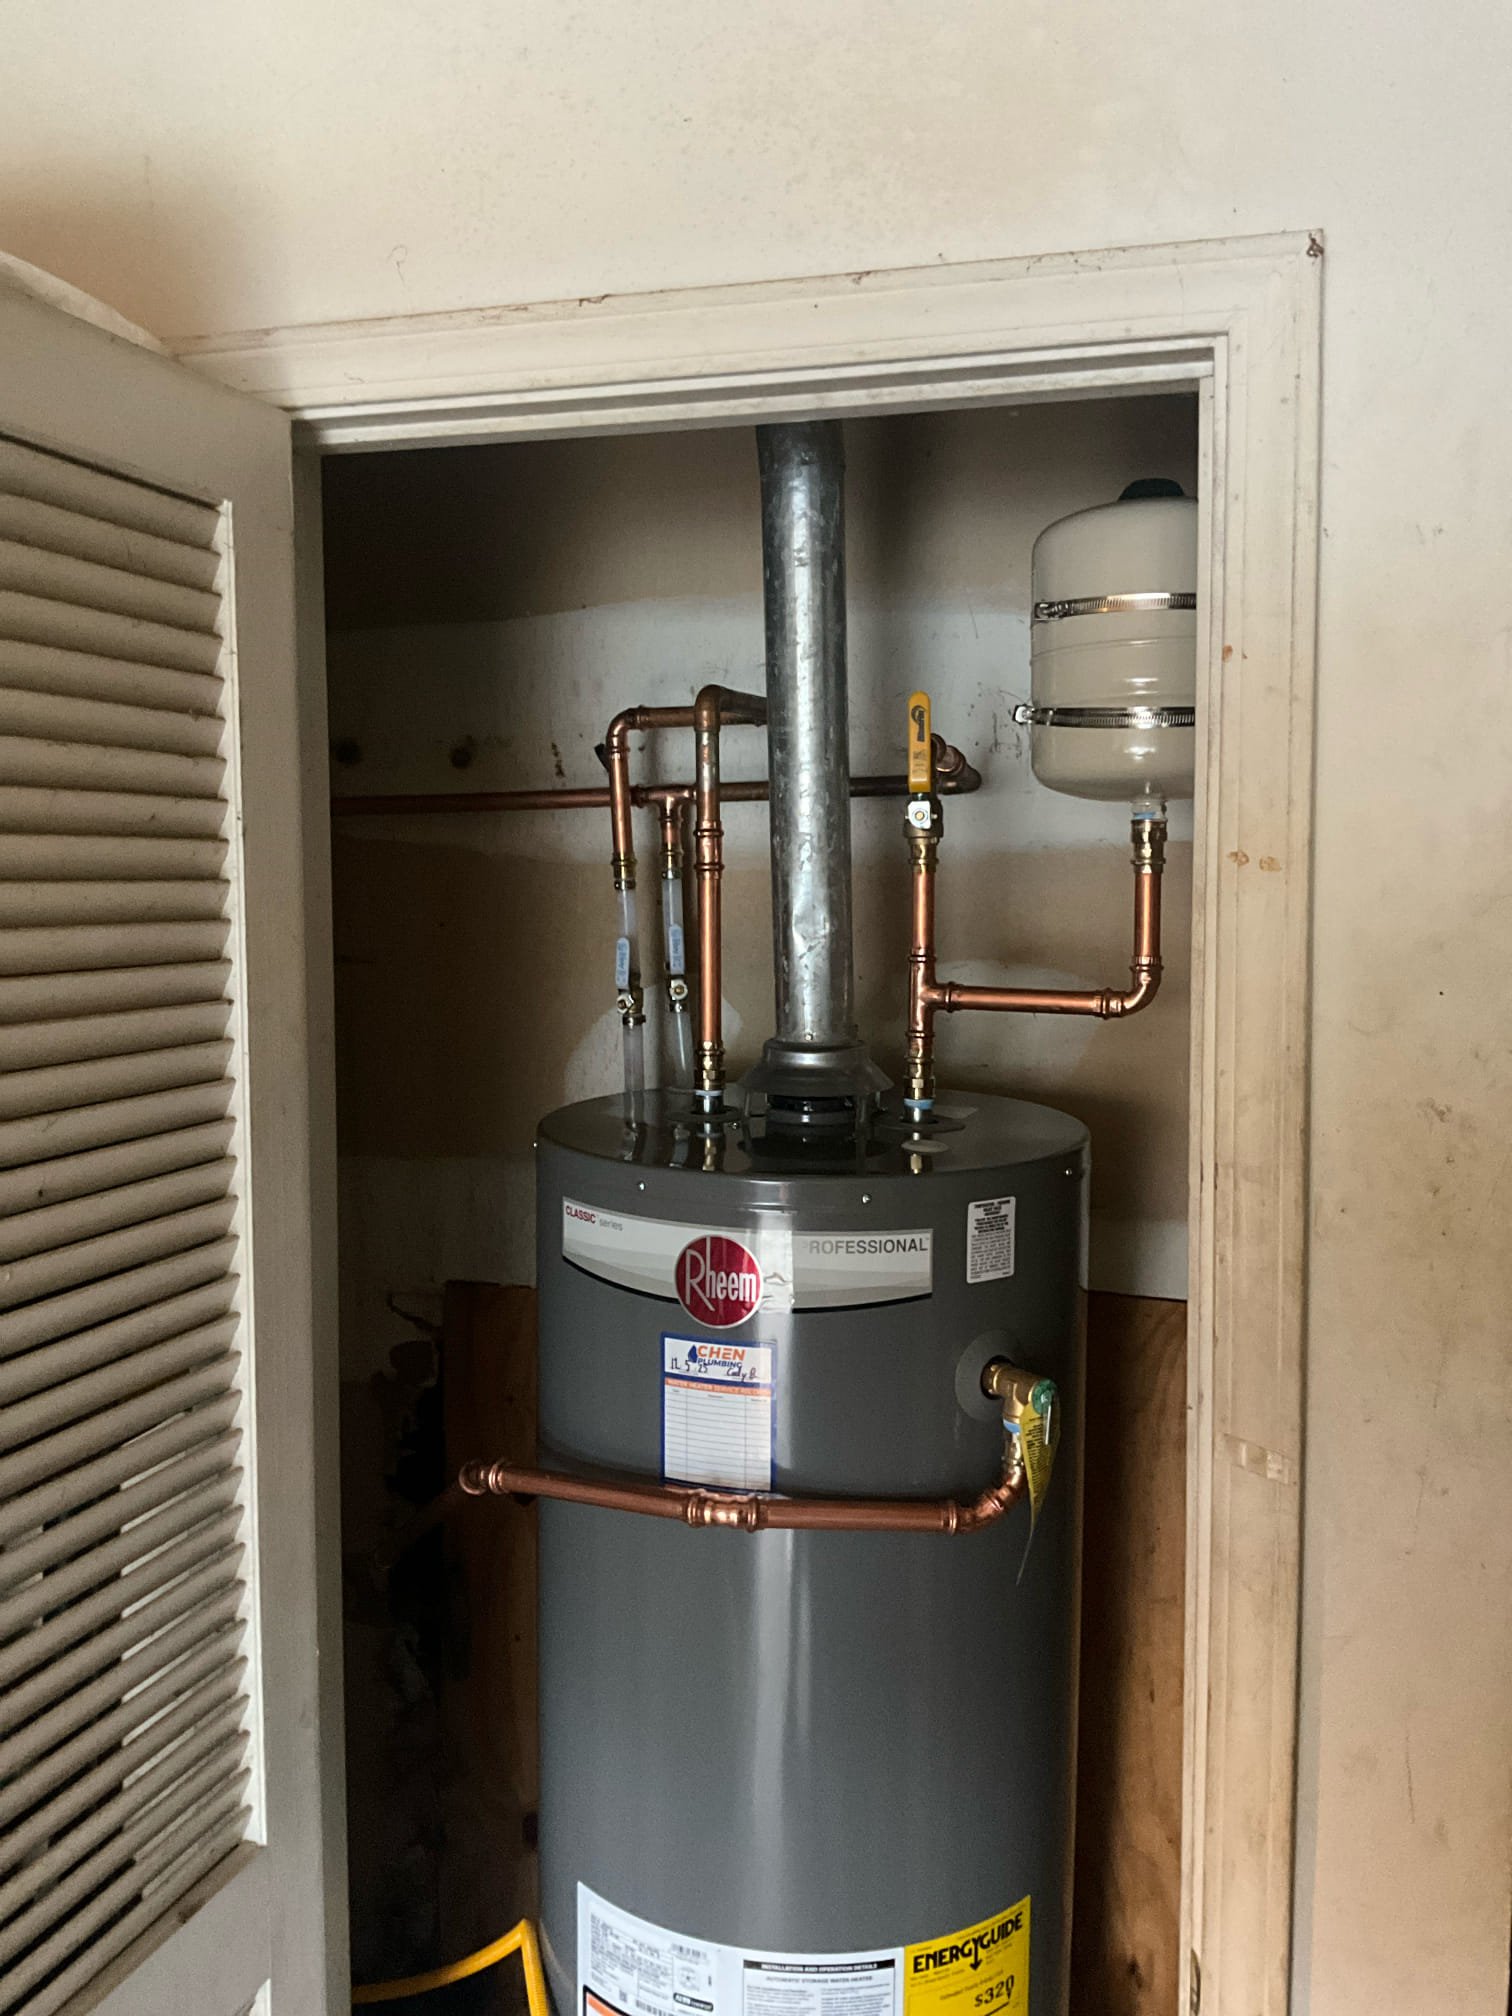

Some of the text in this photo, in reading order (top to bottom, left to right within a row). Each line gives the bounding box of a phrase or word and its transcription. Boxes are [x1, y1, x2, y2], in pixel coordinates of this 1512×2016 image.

[565, 1205, 596, 1224] CLASSIC
[685, 1235, 757, 1312] Rheem
[697, 1345, 746, 1361] CHEN
[697, 1357, 743, 1368] PLUMBING
[912, 1911, 1023, 1974] ENERGYGUIDE
